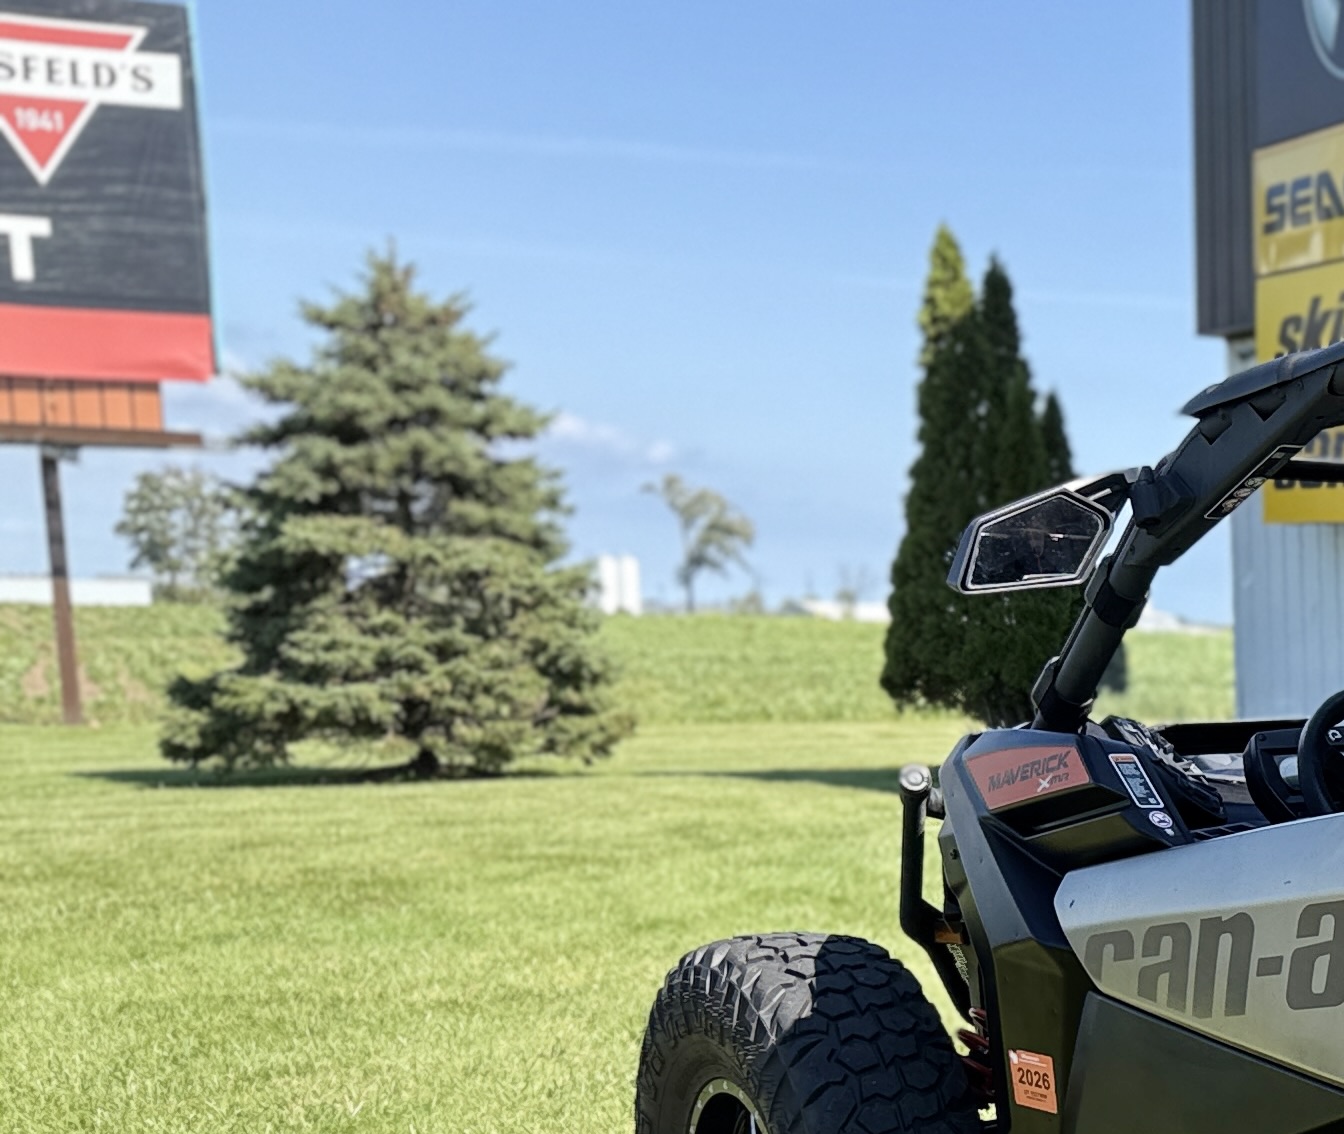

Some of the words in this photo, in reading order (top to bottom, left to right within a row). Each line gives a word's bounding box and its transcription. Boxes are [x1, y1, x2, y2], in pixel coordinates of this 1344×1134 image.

[13, 107, 64, 132] 1941
[988, 750, 1070, 792] MAVERICK
[1017, 1067, 1051, 1090] 2026
